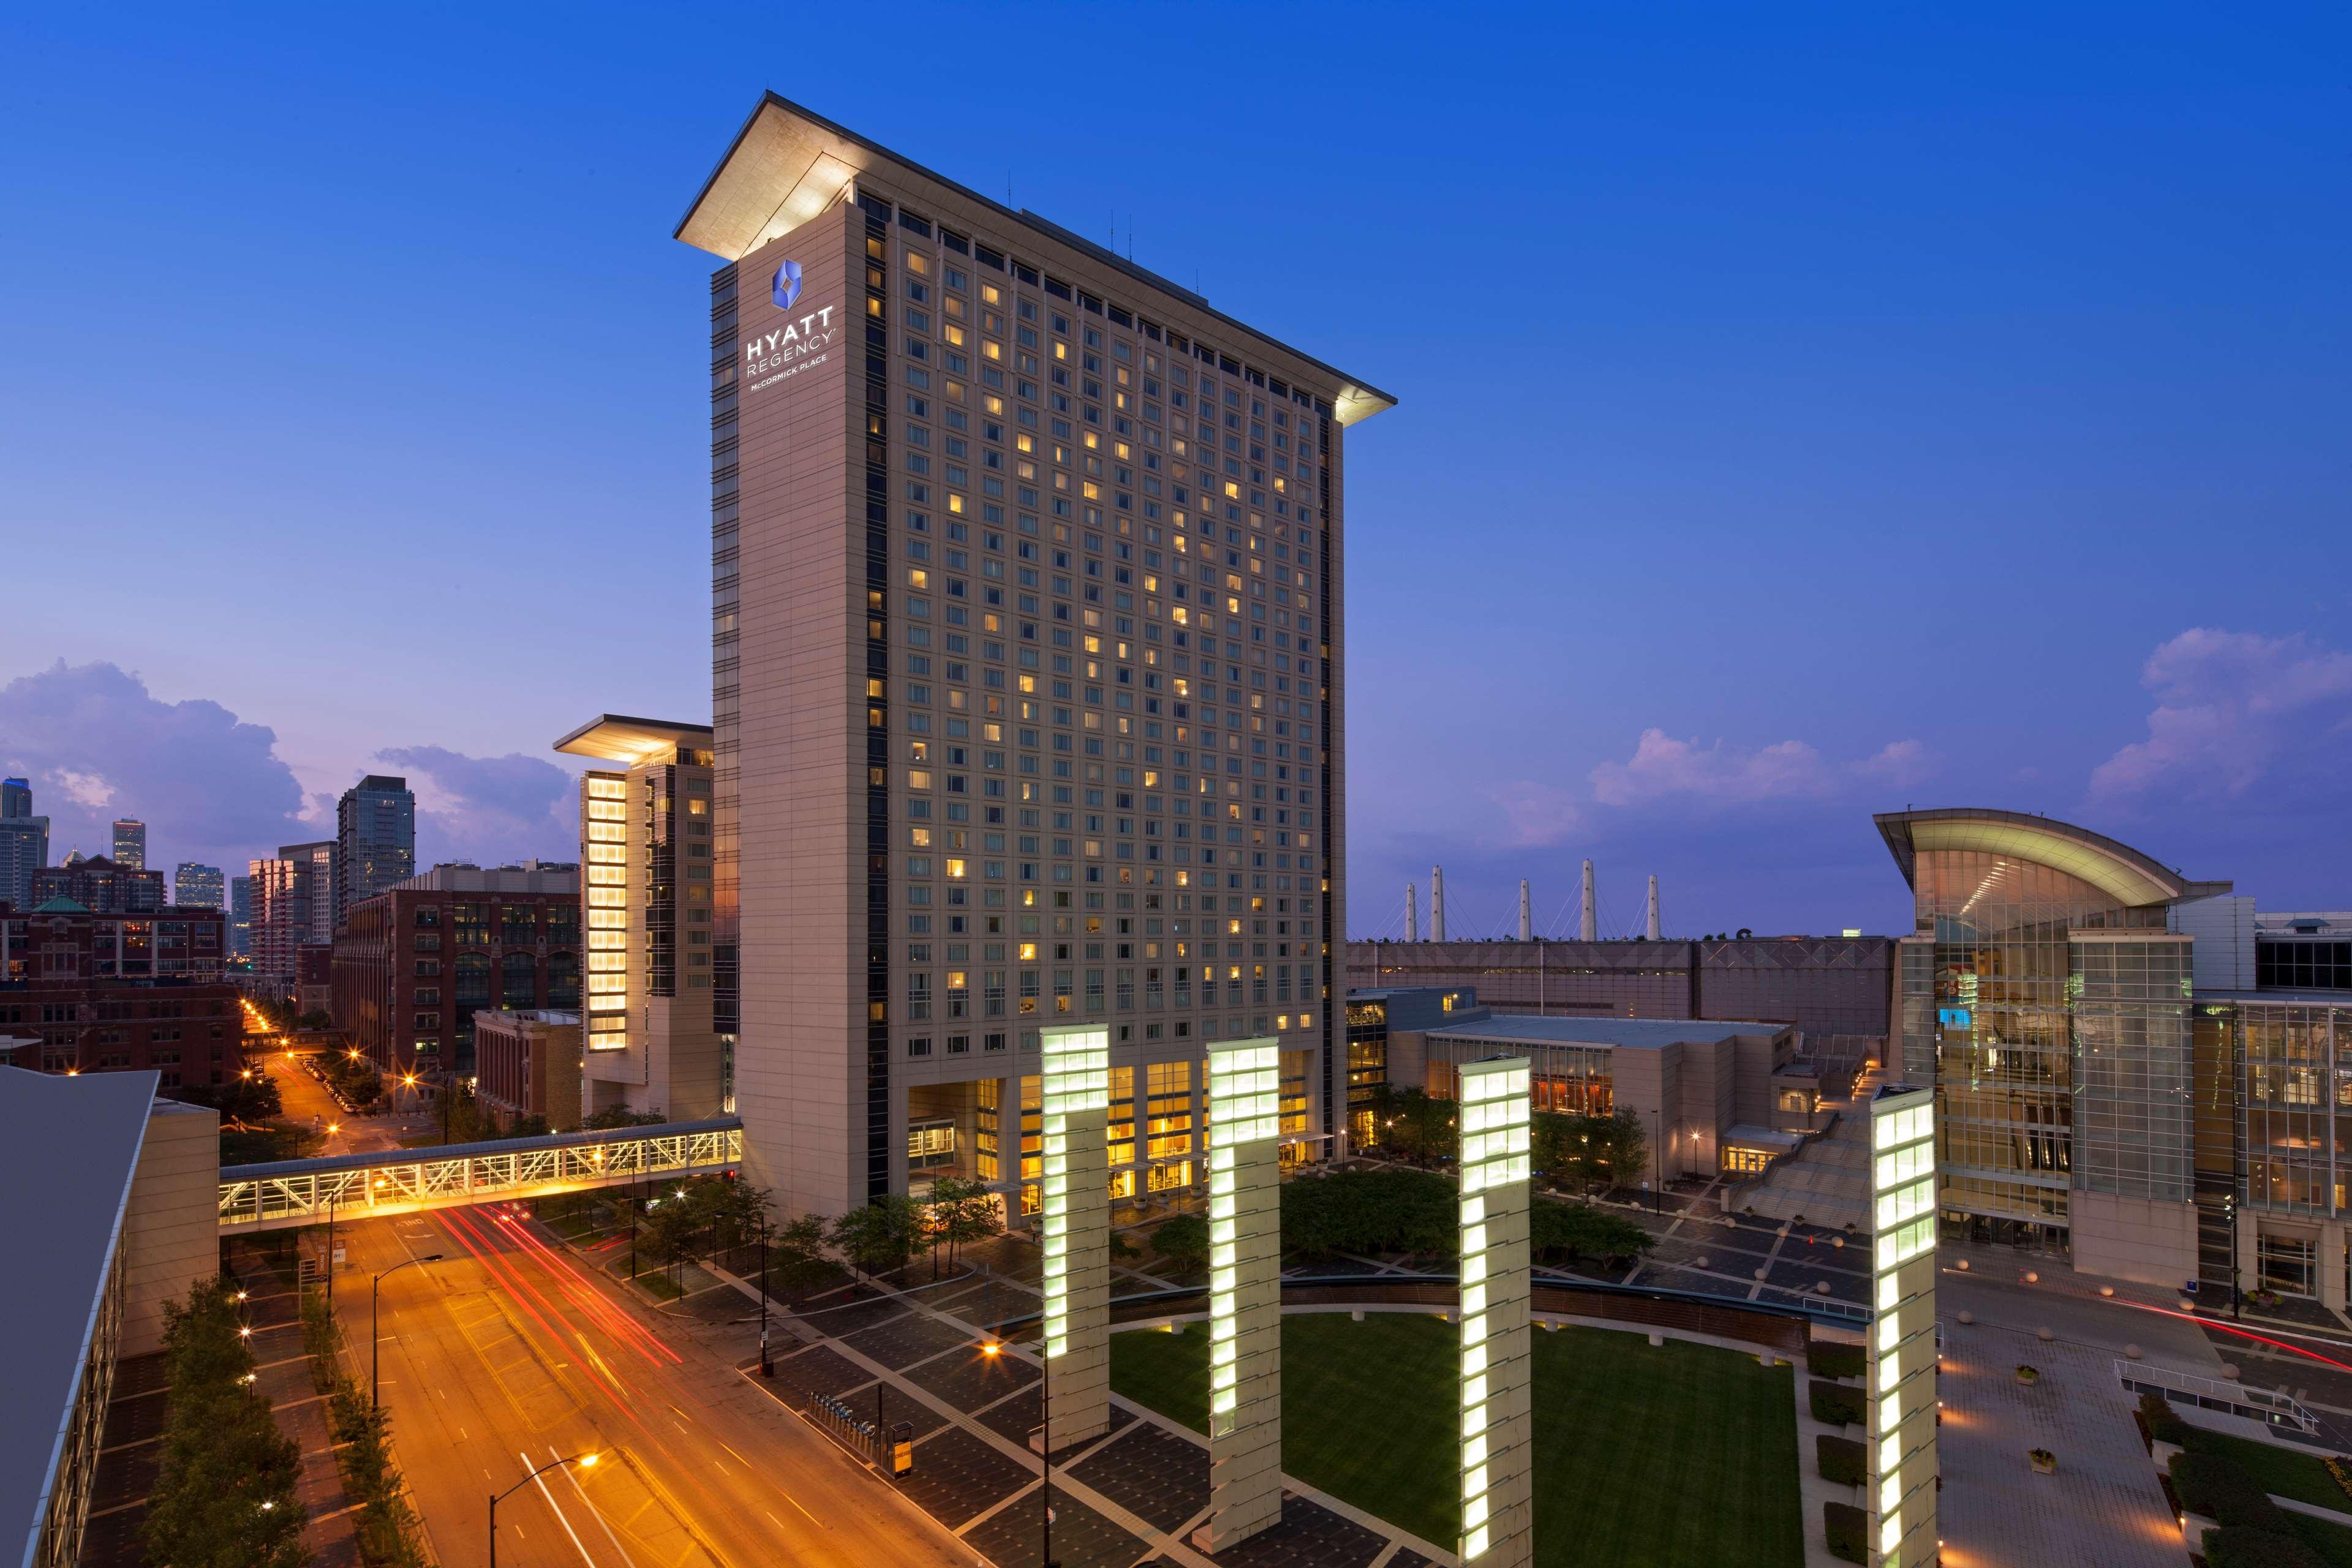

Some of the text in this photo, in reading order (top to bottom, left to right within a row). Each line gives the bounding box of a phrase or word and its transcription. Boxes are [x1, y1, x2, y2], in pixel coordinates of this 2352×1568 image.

[747, 306, 833, 361] HYATT
[747, 329, 834, 378] REGENCY
[751, 354, 827, 391] McCORMICK PLACE
